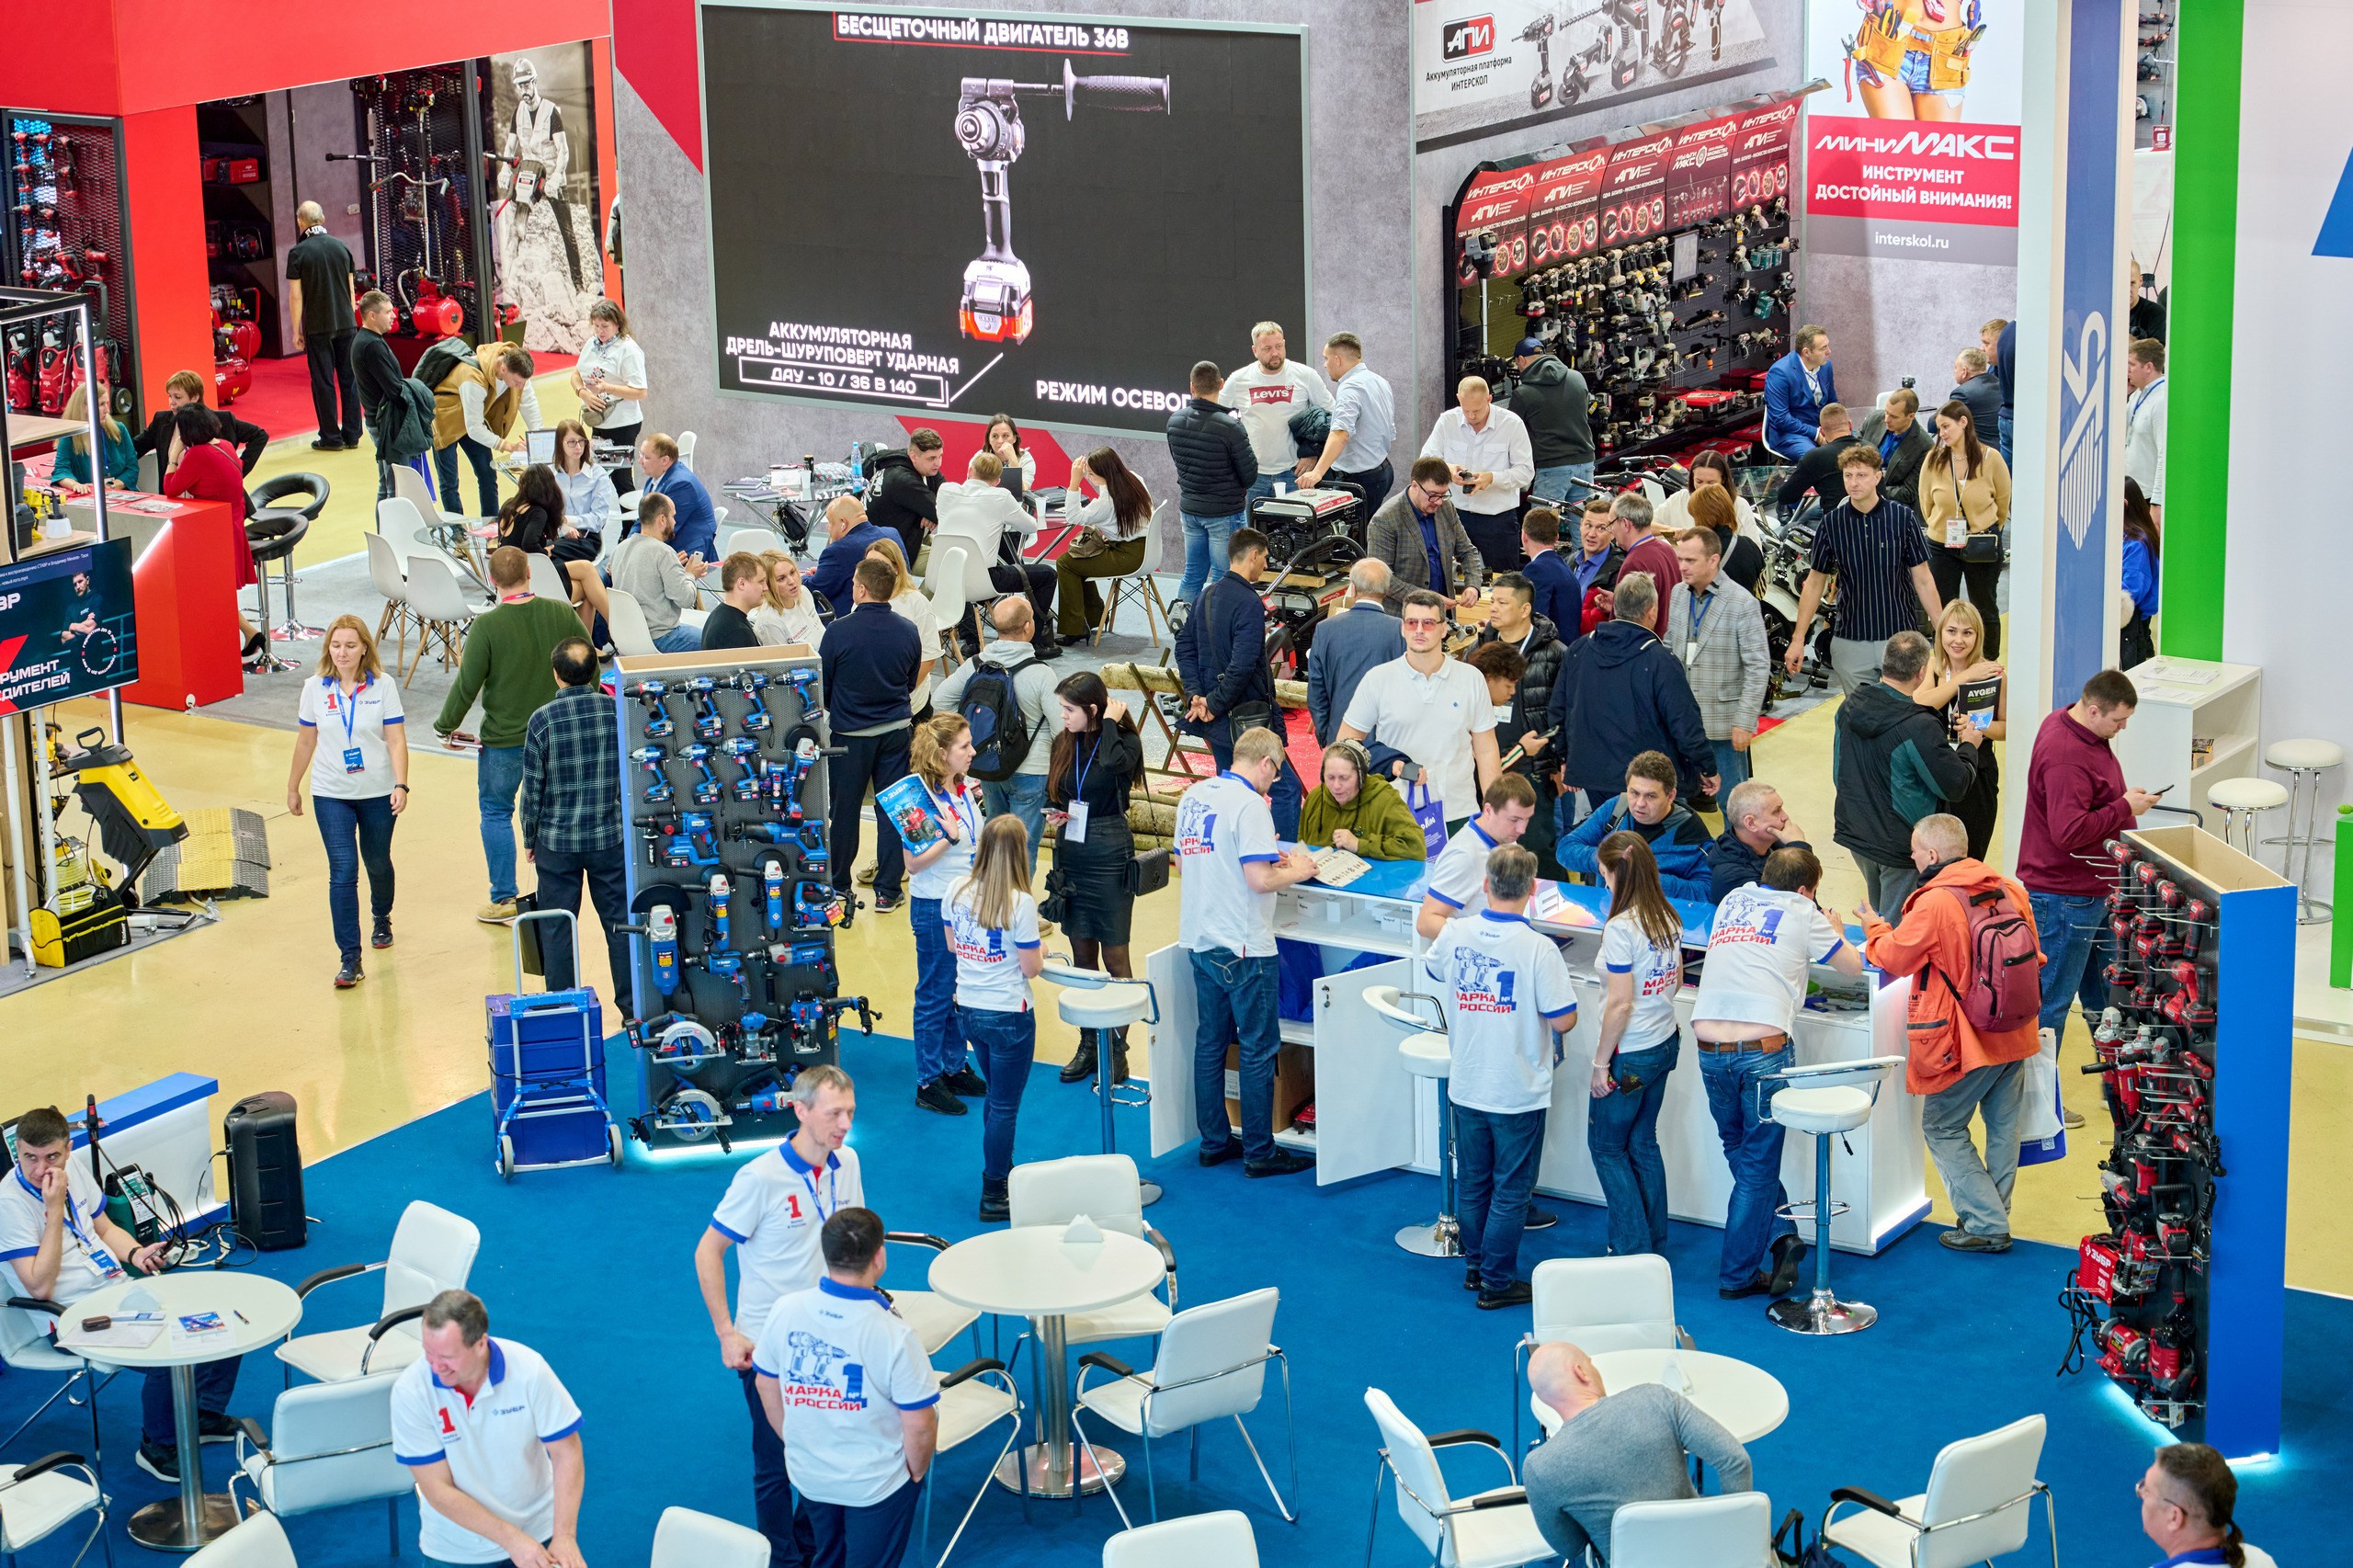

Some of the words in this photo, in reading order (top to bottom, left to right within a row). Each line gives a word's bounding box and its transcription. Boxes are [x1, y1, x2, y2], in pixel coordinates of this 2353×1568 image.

[837, 15, 980, 41] БЕСЩЕТОЧНЫЙ
[983, 22, 1089, 47] ДВИГАТЕЛЬ
[1093, 28, 1129, 49] 36В
[1447, 18, 1490, 52] АПИ
[1426, 63, 1478, 83] Аккумуляторная
[1478, 56, 1513, 73] платформа
[1451, 75, 1488, 92] ИНТЕРСКОЛ
[1742, 104, 1796, 129] ИНТЕРСКОЛ
[1678, 120, 1736, 145] ИНТЕРСКОЛ
[1611, 136, 1673, 163] ИНТЕРСКОЛ
[1540, 153, 1606, 182] ИНТЕРСКОЛ
[1862, 165, 1964, 185] ИНСТРУМЕНТ
[1466, 172, 1534, 199] ИНТЕРСКОЛ
[1815, 184, 1916, 204] ДОСТОЙНЫЙ
[1919, 190, 2012, 210] ВНИМАНИЯ!
[1874, 232, 1949, 249] interskol.ru
[768, 321, 912, 351] АККУМУЛЯТОРНАЯ
[726, 336, 882, 367] ДРЕЛЬ-ШУРУПОВЕРТ
[886, 351, 960, 375] УДАРНАЯ
[817, 371, 835, 387] 10
[850, 376, 870, 390] 36
[874, 378, 885, 392] В
[889, 379, 916, 394] 140
[1036, 380, 1108, 405] РЕЖИМ
[0, 672, 70, 701] ДИТЕЛЕЙ
[1967, 686, 1996, 697] AYGER
[327, 693, 337, 710] 1
[888, 783, 908, 799] ЗУБР
[1201, 814, 1217, 851] 1
[1755, 909, 1785, 945] 1
[986, 926, 1007, 959] 1
[1715, 934, 1771, 947] РОССИИ
[957, 950, 1003, 962] РОССИИ
[1495, 971, 1517, 1011] 1
[1460, 1003, 1511, 1014] РОССИИ
[788, 1194, 802, 1219] 1
[2091, 1248, 2111, 1268] ЗУБР
[784, 1383, 842, 1399] МАРКА
[841, 1363, 868, 1408] 1
[500, 1405, 525, 1415] ЗУБР
[794, 1397, 861, 1411] РОССИИ
[438, 1407, 456, 1434] 1
